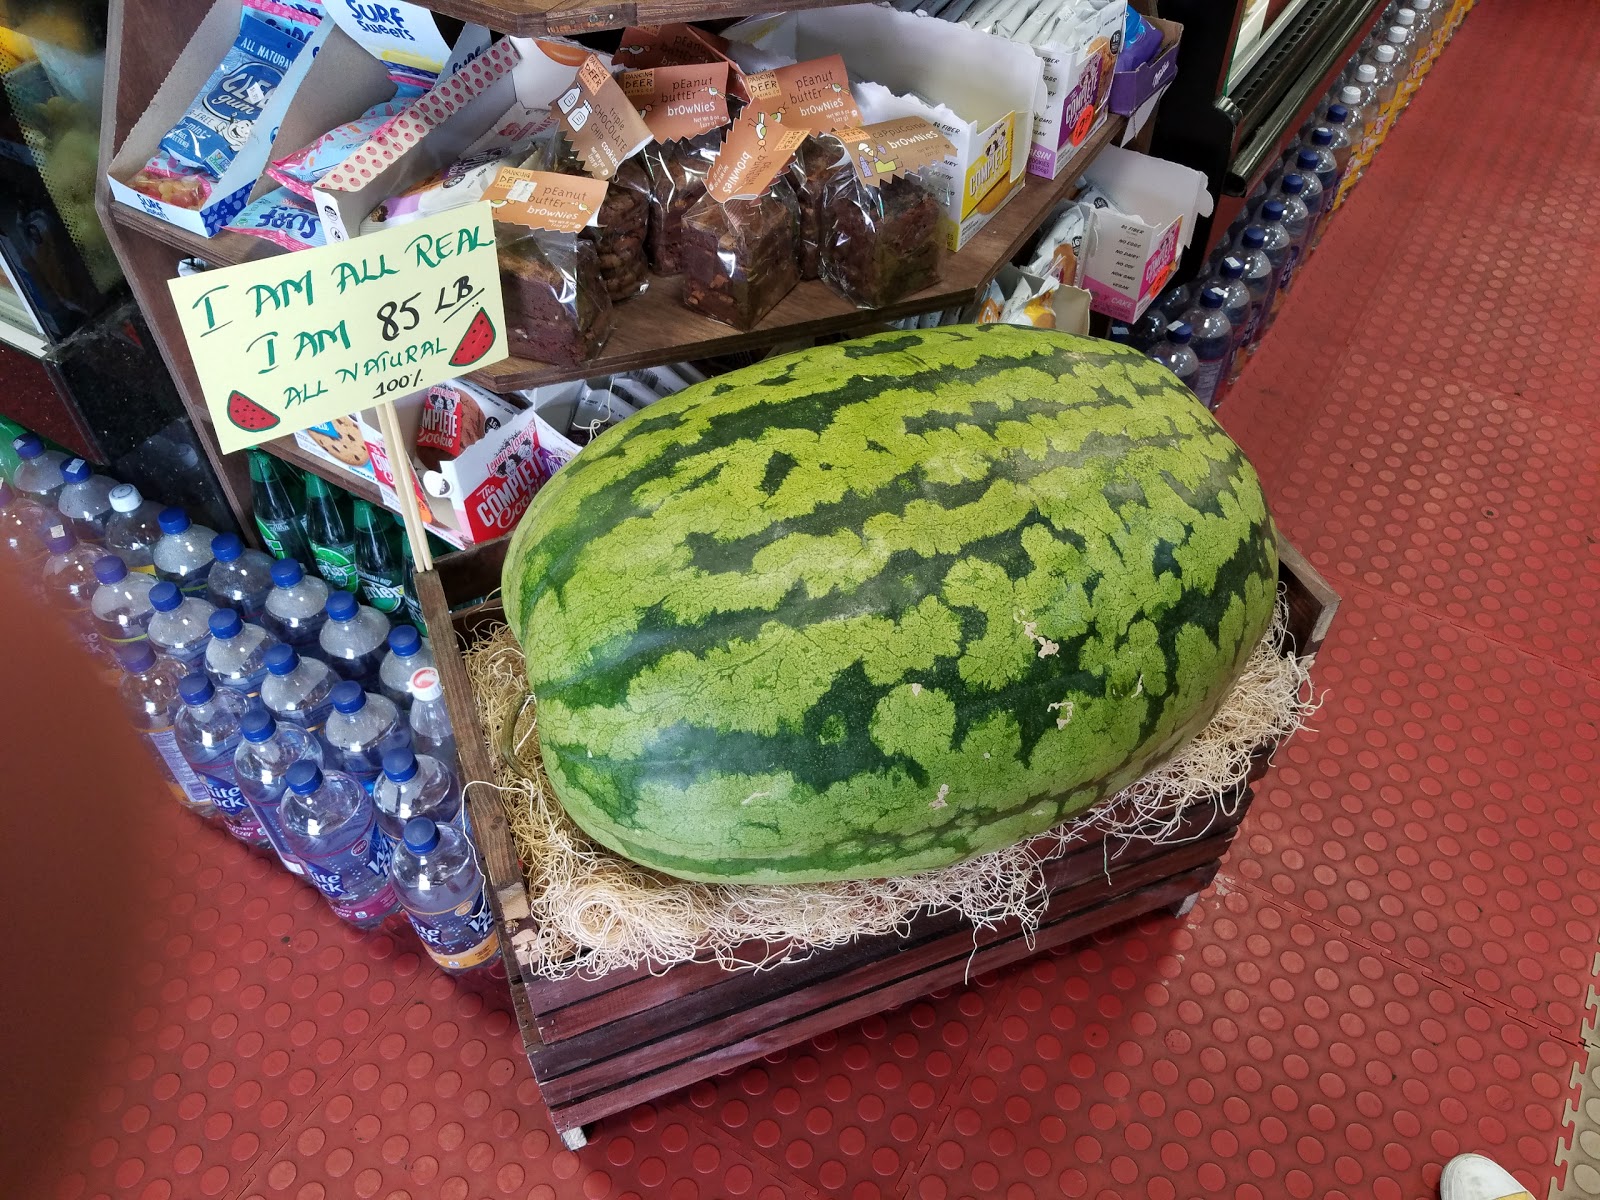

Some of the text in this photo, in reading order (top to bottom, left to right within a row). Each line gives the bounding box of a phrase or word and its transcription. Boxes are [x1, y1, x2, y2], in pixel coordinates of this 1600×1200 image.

[240, 37, 256, 53] ALL
[584, 62, 602, 88] DEER
[625, 78, 653, 89] DEER
[750, 80, 778, 93] DEER
[211, 93, 254, 115] gum
[593, 103, 628, 153] CHOCOLATE
[609, 107, 625, 131] triple
[941, 124, 961, 135] FIBER
[590, 122, 604, 140] CHIP
[601, 141, 619, 167] cookies
[192, 225, 495, 338] I AM ALL REAL
[1111, 297, 1133, 308] CAKE
[246, 331, 280, 375] I
[294, 319, 351, 361] AM
[376, 292, 422, 342] 85
[284, 337, 448, 409] ALL NATURAL
[422, 408, 458, 438] MPLETE
[486, 420, 536, 475] Lenny & Larry's
[476, 484, 496, 500] The
[477, 447, 546, 527] COMPLETE
[204, 782, 241, 799] hite
[211, 797, 248, 809] ock
